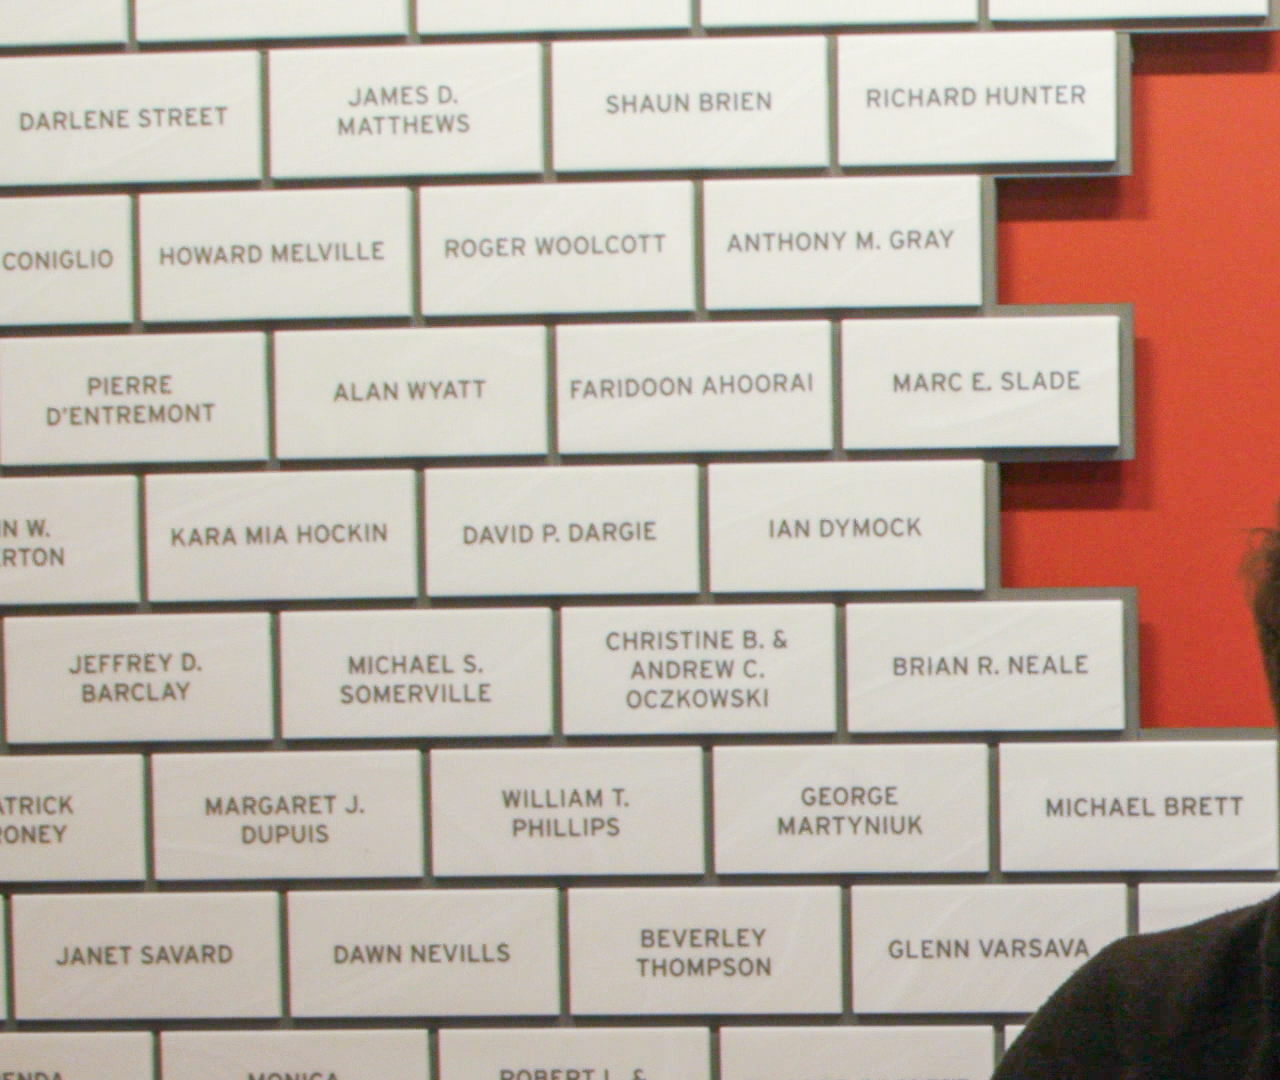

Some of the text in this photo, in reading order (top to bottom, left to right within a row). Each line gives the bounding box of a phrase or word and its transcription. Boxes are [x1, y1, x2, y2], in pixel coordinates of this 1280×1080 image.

[348, 85, 429, 108] JAMES
[605, 91, 772, 115] SHAUN BRIEN
[866, 84, 1086, 109] RICHARD HUNTER
[19, 106, 228, 132] DARLENE STREET
[337, 113, 471, 136] MATTHEWS
[444, 233, 666, 259] ROGER WOOLCOTT
[726, 229, 955, 253] ANTHONY M. GRAY
[1, 248, 114, 272] CONIGLIO
[159, 240, 385, 267] HOWARD MELVILLE
[87, 374, 172, 396] PIERRE
[333, 379, 486, 403] ALAN WYATT
[569, 372, 813, 400] FARIDOON AHOORAI
[892, 370, 1081, 393] MARC SLADE
[46, 402, 215, 427] D'ENTREMONT
[170, 523, 388, 547] KARA MIA HOCKIN
[462, 520, 657, 546] DAVID DARGIE
[769, 517, 922, 539] IAN DYMOCK
[605, 629, 734, 652] CHRISTINE
[68, 652, 173, 675] JEFFREY
[348, 654, 455, 675] MICHAEL
[630, 659, 735, 680] ANDREW
[892, 654, 1089, 677] BRIAN NEALE
[81, 681, 190, 704] BARCLAY
[339, 683, 492, 705] SOMERVILLE
[625, 688, 769, 710] OCZKOWSKI
[204, 794, 337, 817] MARGARET
[501, 788, 603, 809] WILLIAM
[800, 785, 898, 807] GEORGE
[1045, 795, 1244, 818] MICHAEL BRETT
[241, 823, 330, 845] DUPUIS
[511, 816, 621, 838] PHILLIPS
[777, 815, 923, 836] MARTYNIUK
[640, 927, 767, 949] BEVERLEY
[888, 938, 1090, 960] GLENN VARSAVA
[55, 943, 233, 967] JANET SAVARD
[333, 942, 511, 965] DAWN NEVILLS
[636, 956, 772, 978] THOMPSON
